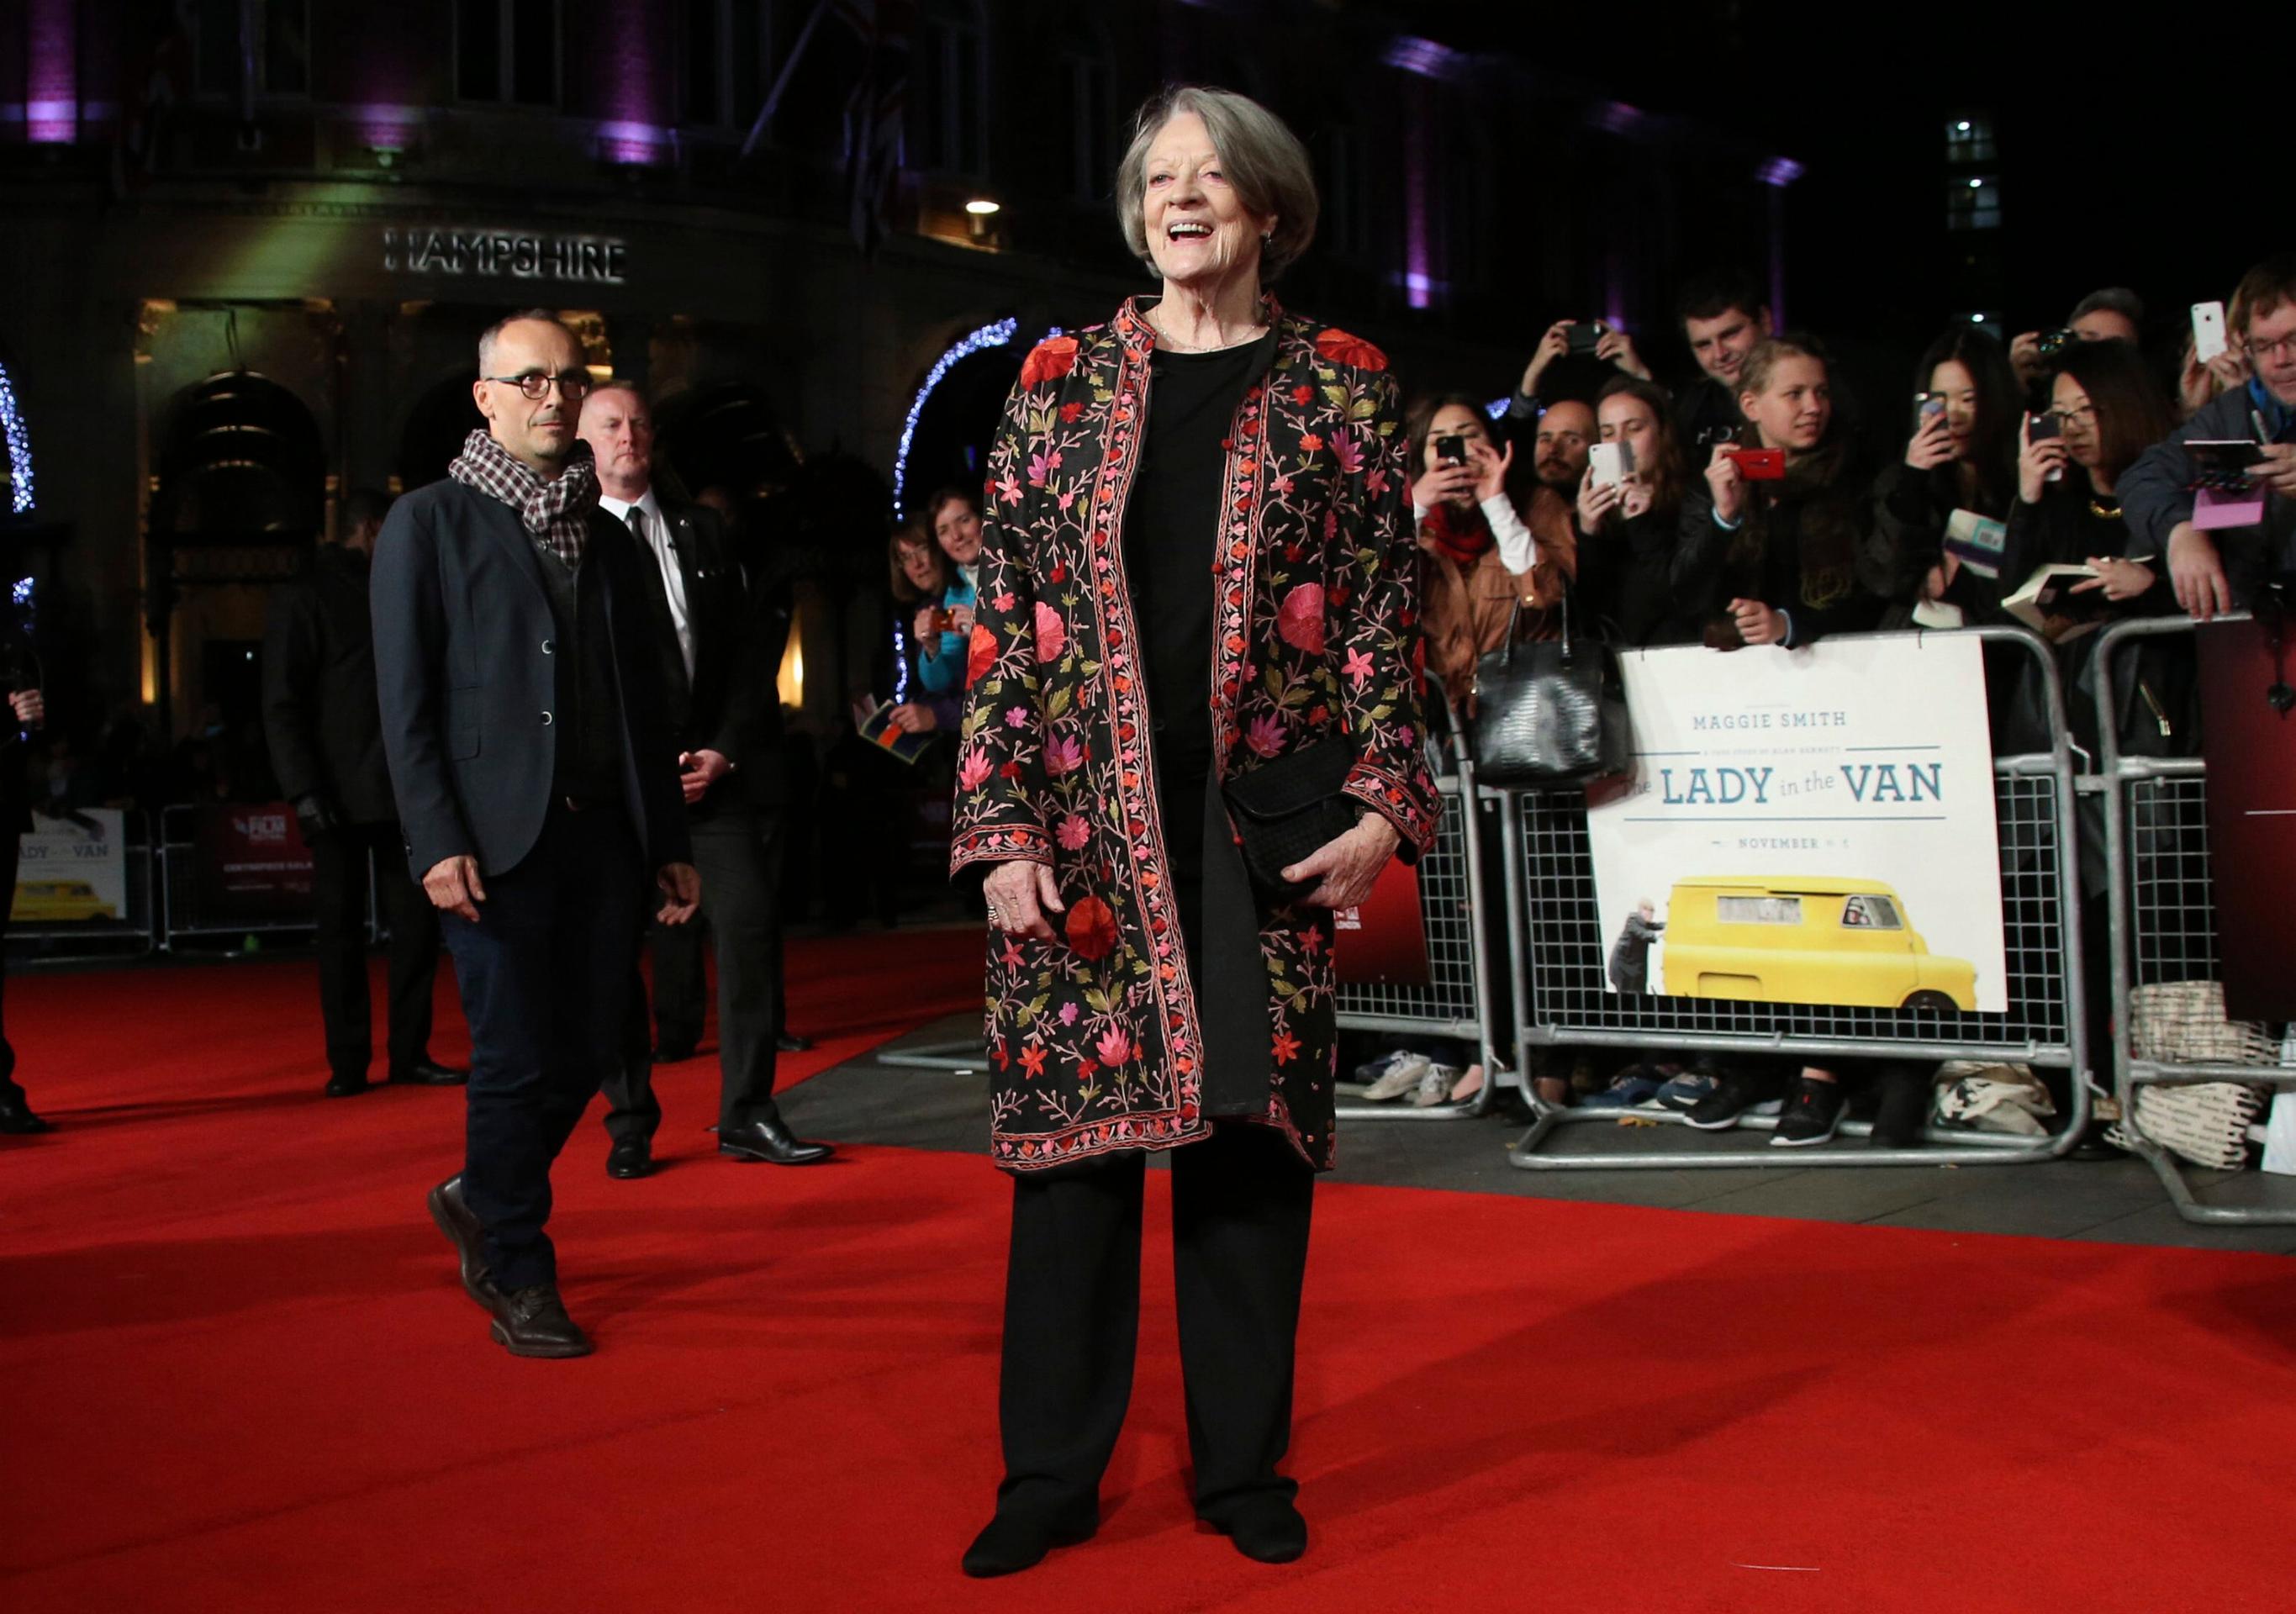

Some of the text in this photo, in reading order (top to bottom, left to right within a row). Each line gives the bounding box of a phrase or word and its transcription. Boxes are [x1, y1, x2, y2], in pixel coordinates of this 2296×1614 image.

[383, 227, 627, 283] HAMPSHIRE
[1692, 711, 1847, 730] MAGGIE SMITH
[1660, 767, 1774, 804] LADY
[1780, 778, 1800, 797] in
[1804, 773, 1835, 793] the
[1839, 762, 1943, 802] VAN
[18, 846, 50, 859] ADY
[72, 844, 108, 858] VAN
[1738, 836, 1819, 849] NOVEMBER
